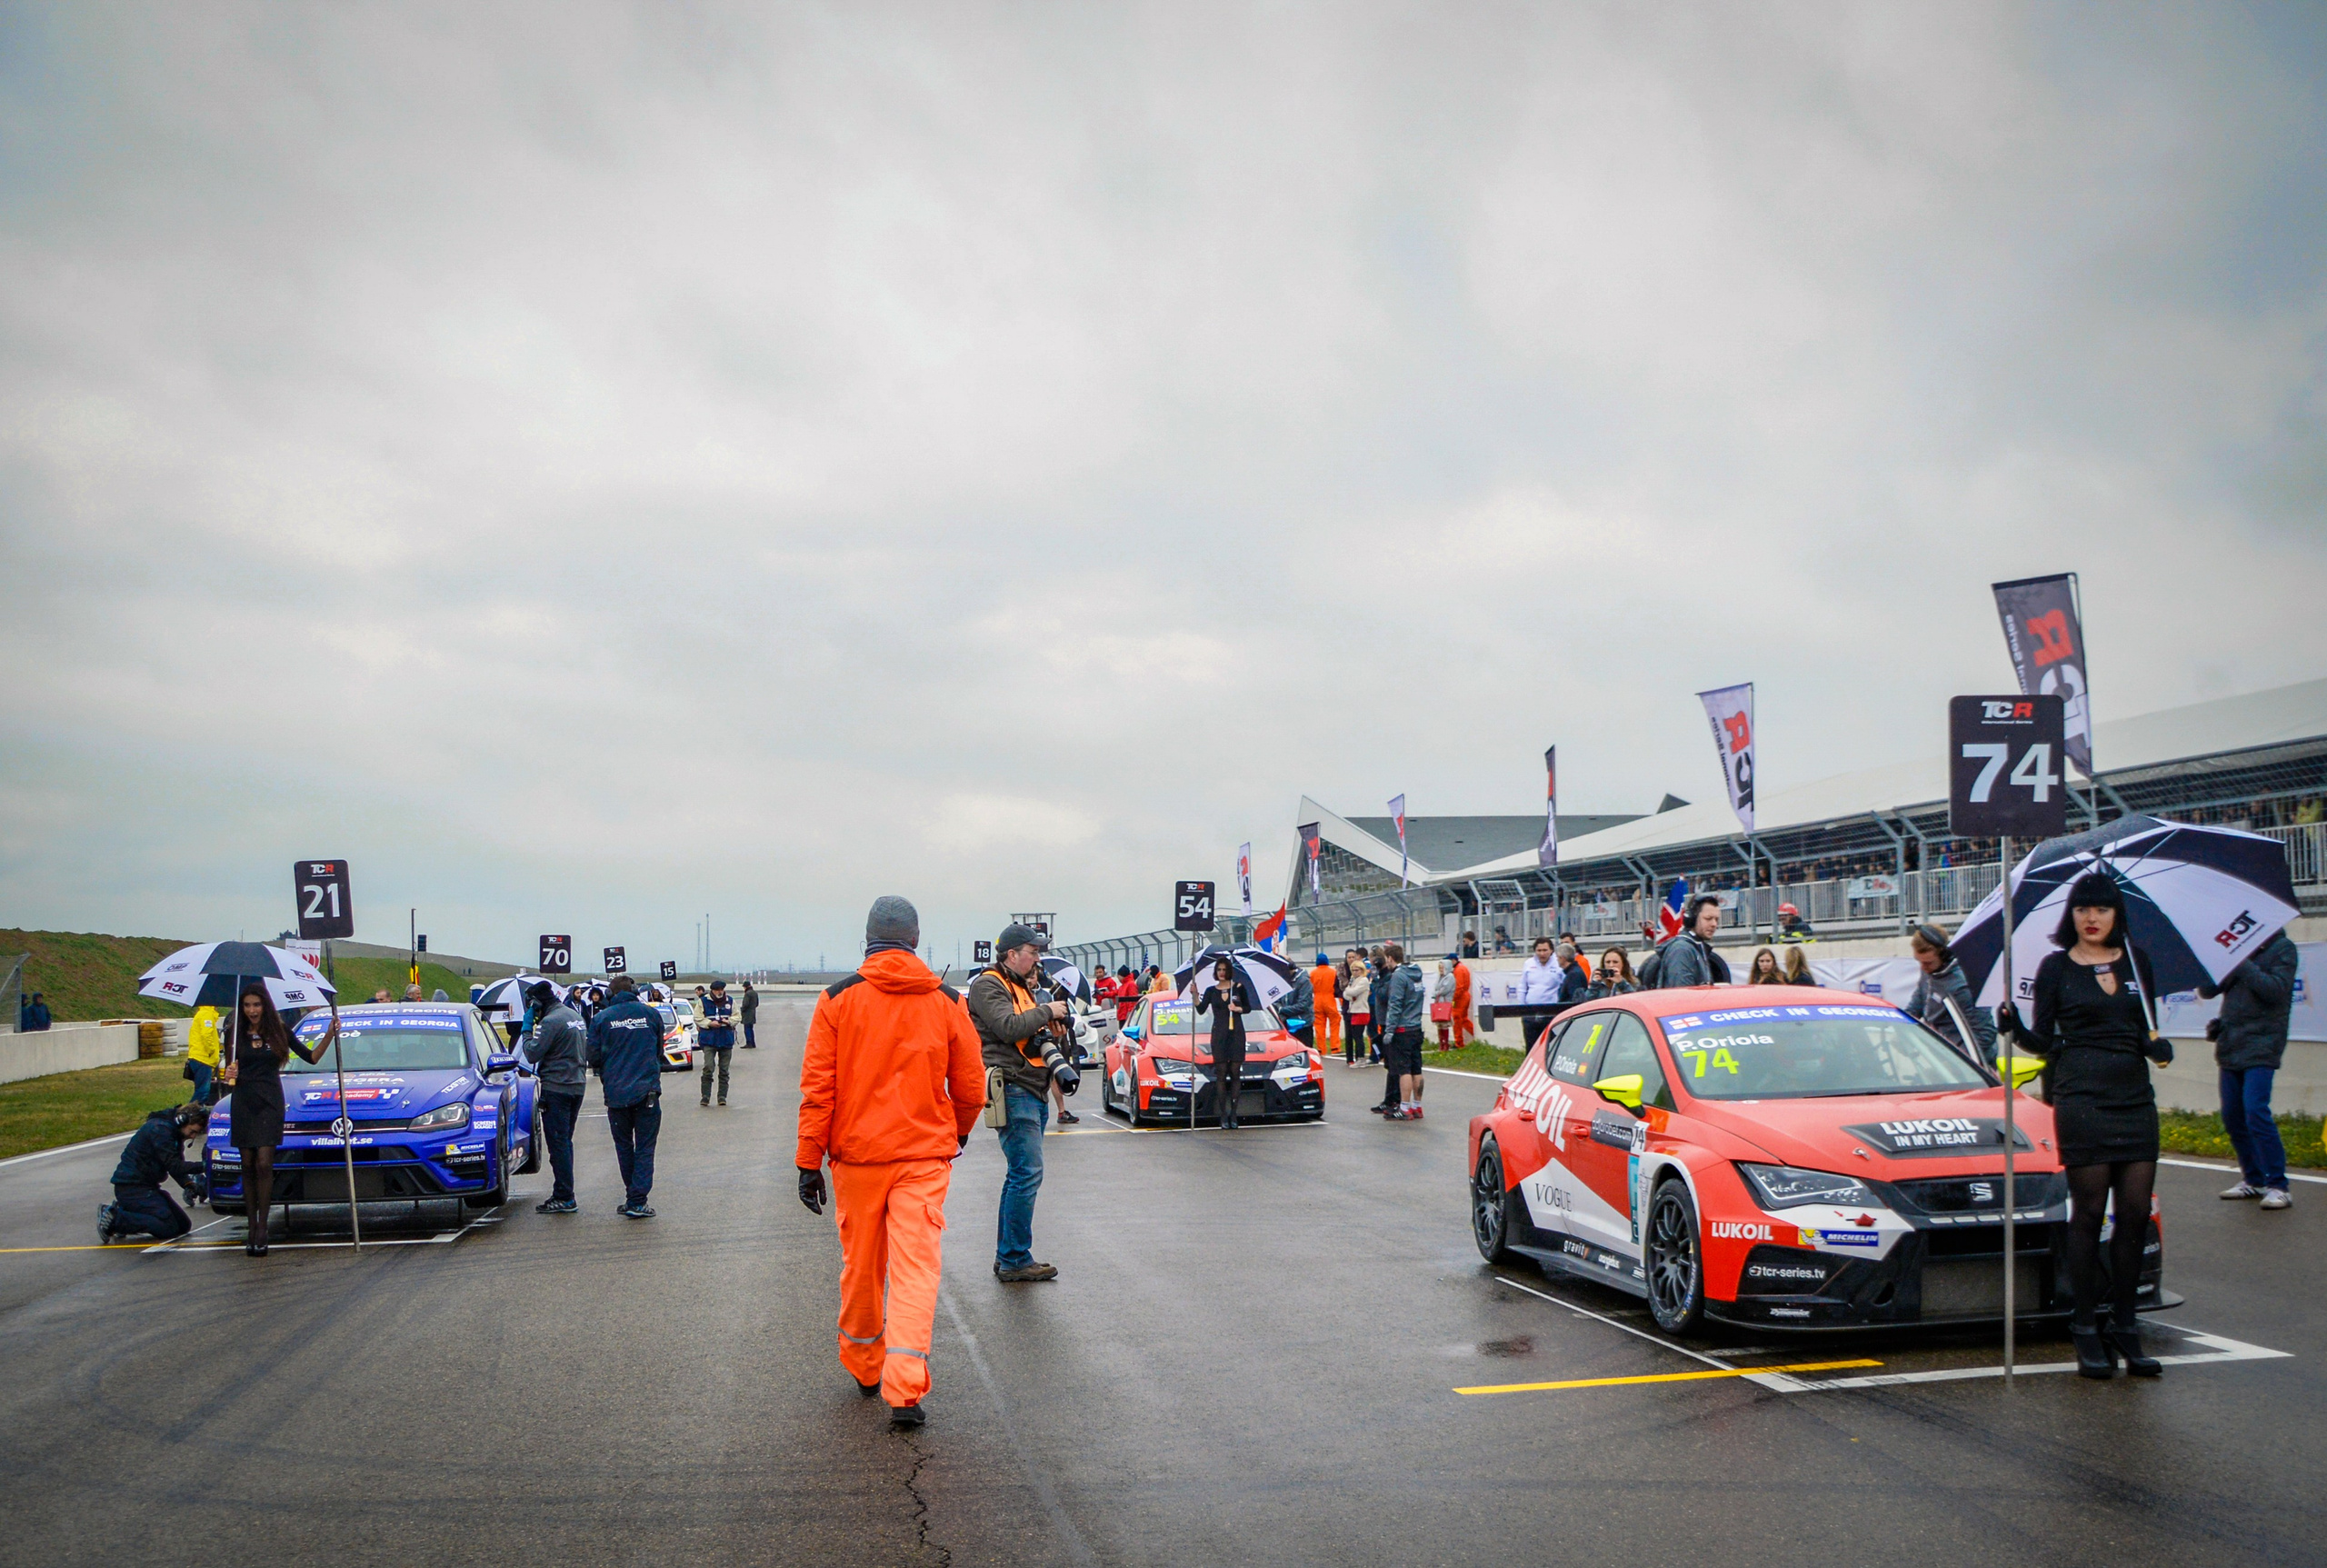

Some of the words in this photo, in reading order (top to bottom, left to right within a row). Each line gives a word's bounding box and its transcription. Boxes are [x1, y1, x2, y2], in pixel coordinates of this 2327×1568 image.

[1981, 701, 2033, 718] TCR
[1962, 744, 2059, 803] 74
[311, 864, 335, 874] TCR
[303, 883, 340, 918] 21
[1178, 895, 1212, 919] 54
[543, 948, 569, 966] 70
[977, 948, 990, 958] 18
[606, 955, 624, 969] 23
[290, 969, 315, 980] TCR
[663, 966, 674, 976] 15
[610, 1017, 647, 1027] WestCoast
[1156, 1014, 1180, 1025] 54
[1710, 1008, 1776, 1023] CHECK
[1786, 1007, 1809, 1016] IN
[1817, 1006, 1903, 1019] GEORGIA
[400, 1019, 459, 1028] GEORGIA
[1676, 1034, 1774, 1052] P.Oriola
[1682, 1048, 1740, 1078] 74
[305, 1092, 333, 1101] TCR
[1507, 1057, 1573, 1153] LUKOIL
[1879, 1118, 1980, 1134] LUKOIL
[1894, 1135, 1912, 1147] IN
[1913, 1134, 1933, 1145] MY
[1935, 1133, 1978, 1144] HEART
[1535, 1183, 1573, 1213] VOGUE
[1712, 1222, 1773, 1241] LUKOIL
[1827, 1233, 1878, 1242] MICHELIN
[1762, 1266, 1826, 1279] tcr-series.tv
